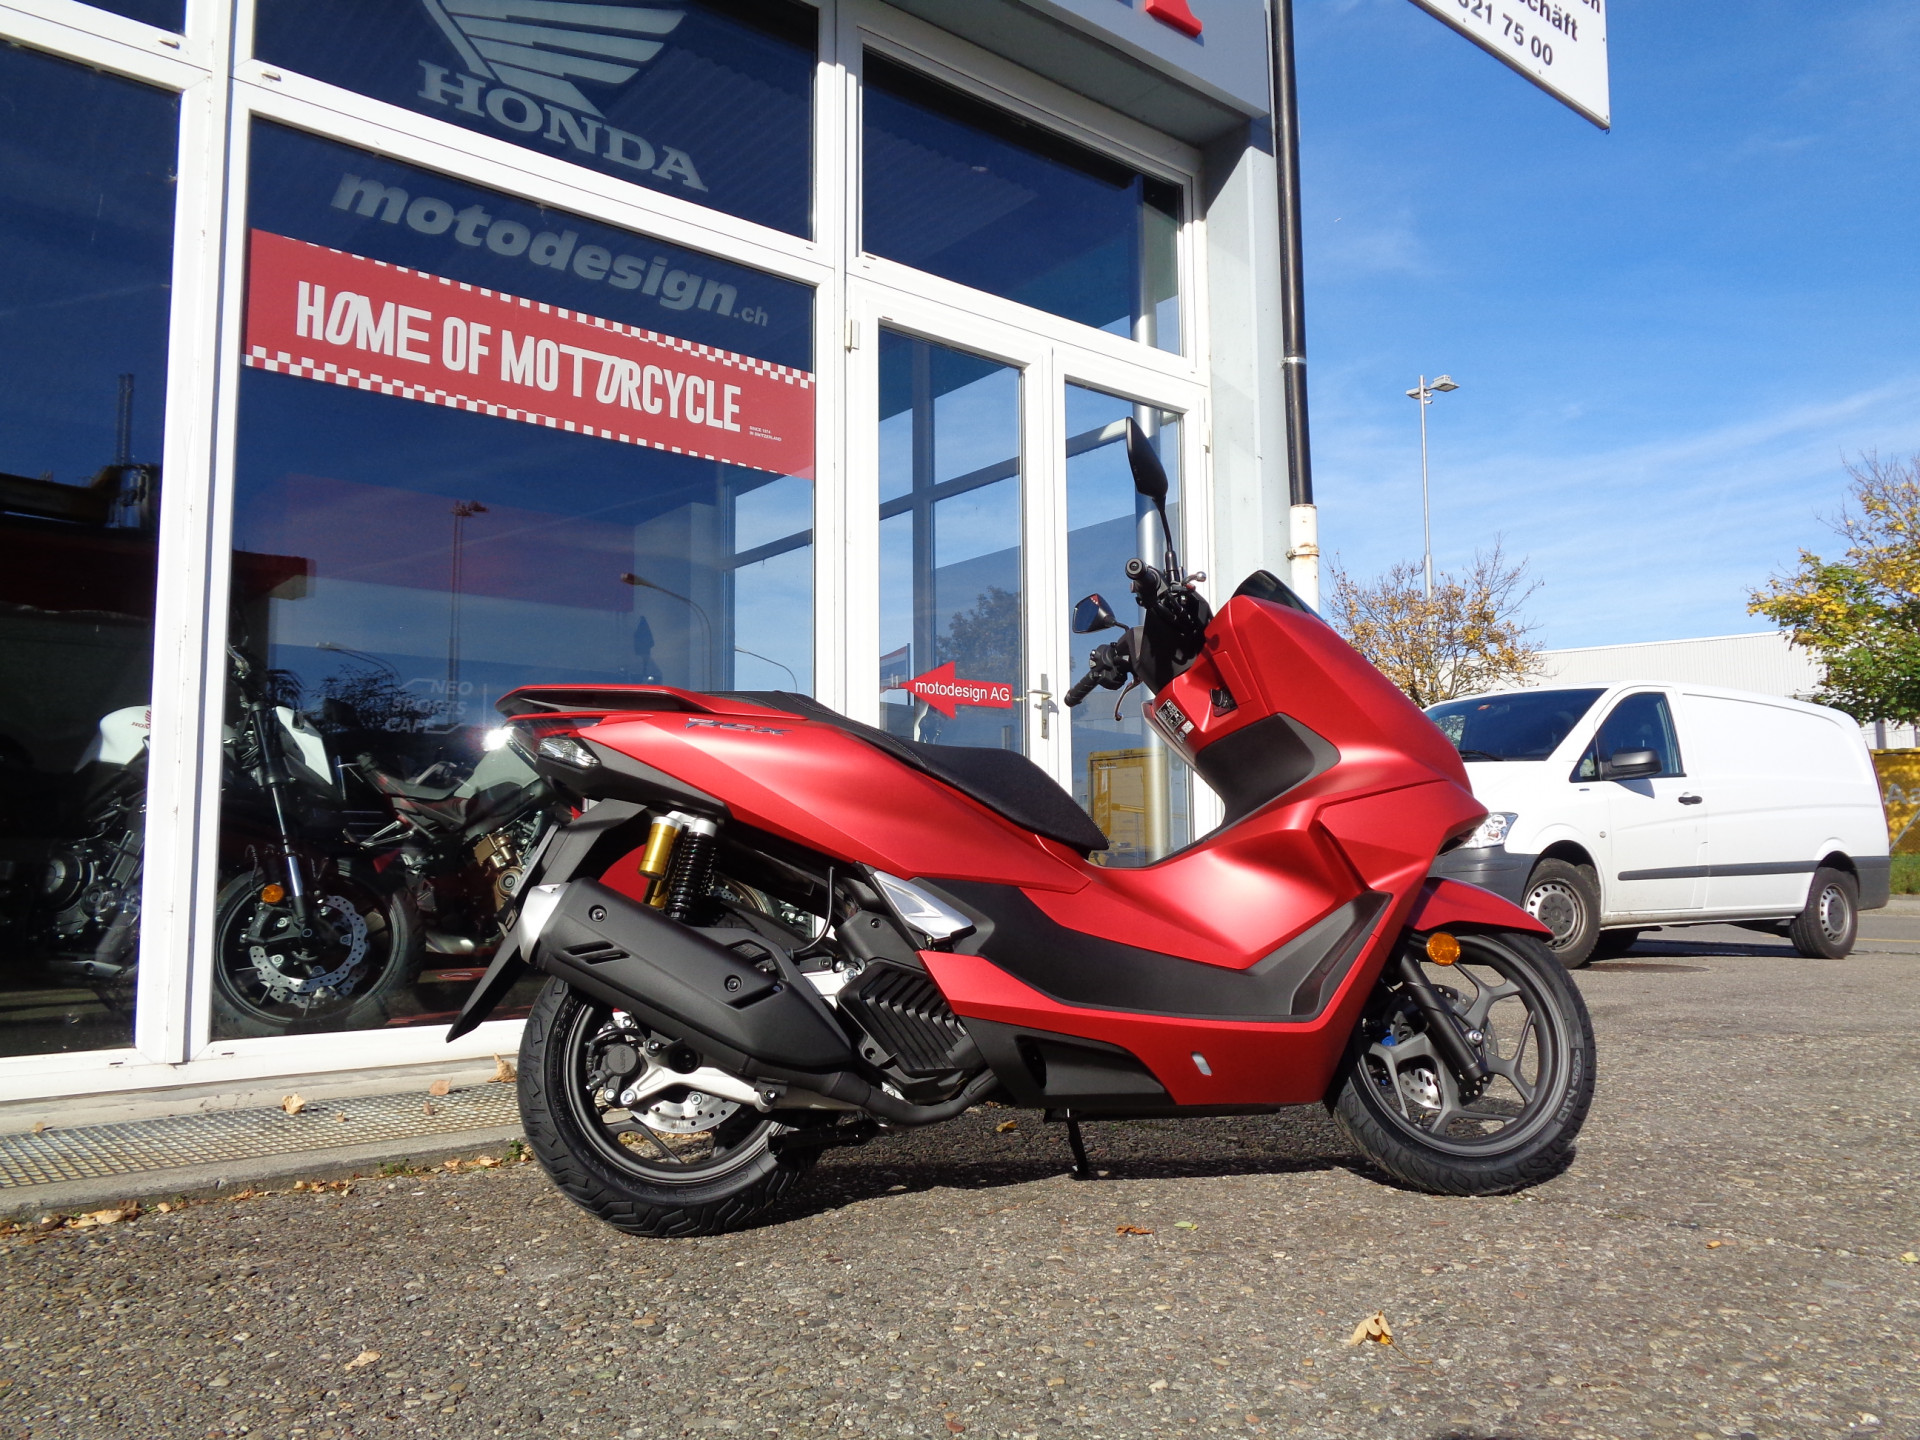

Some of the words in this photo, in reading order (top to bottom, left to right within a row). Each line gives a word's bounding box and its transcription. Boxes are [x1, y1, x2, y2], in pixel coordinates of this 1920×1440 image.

[1503, 13, 1525, 46] 75
[1531, 35, 1553, 66] 00
[1519, 0, 1577, 42] chäft
[417, 59, 709, 193] HONDA
[296, 280, 432, 364] HOME
[442, 316, 492, 375] OF
[391, 696, 468, 716] SPORTS
[430, 680, 474, 696] NEO
[915, 681, 987, 702] motodesign
[990, 687, 1010, 701] AG
[1557, 1088, 1578, 1122] CITY
